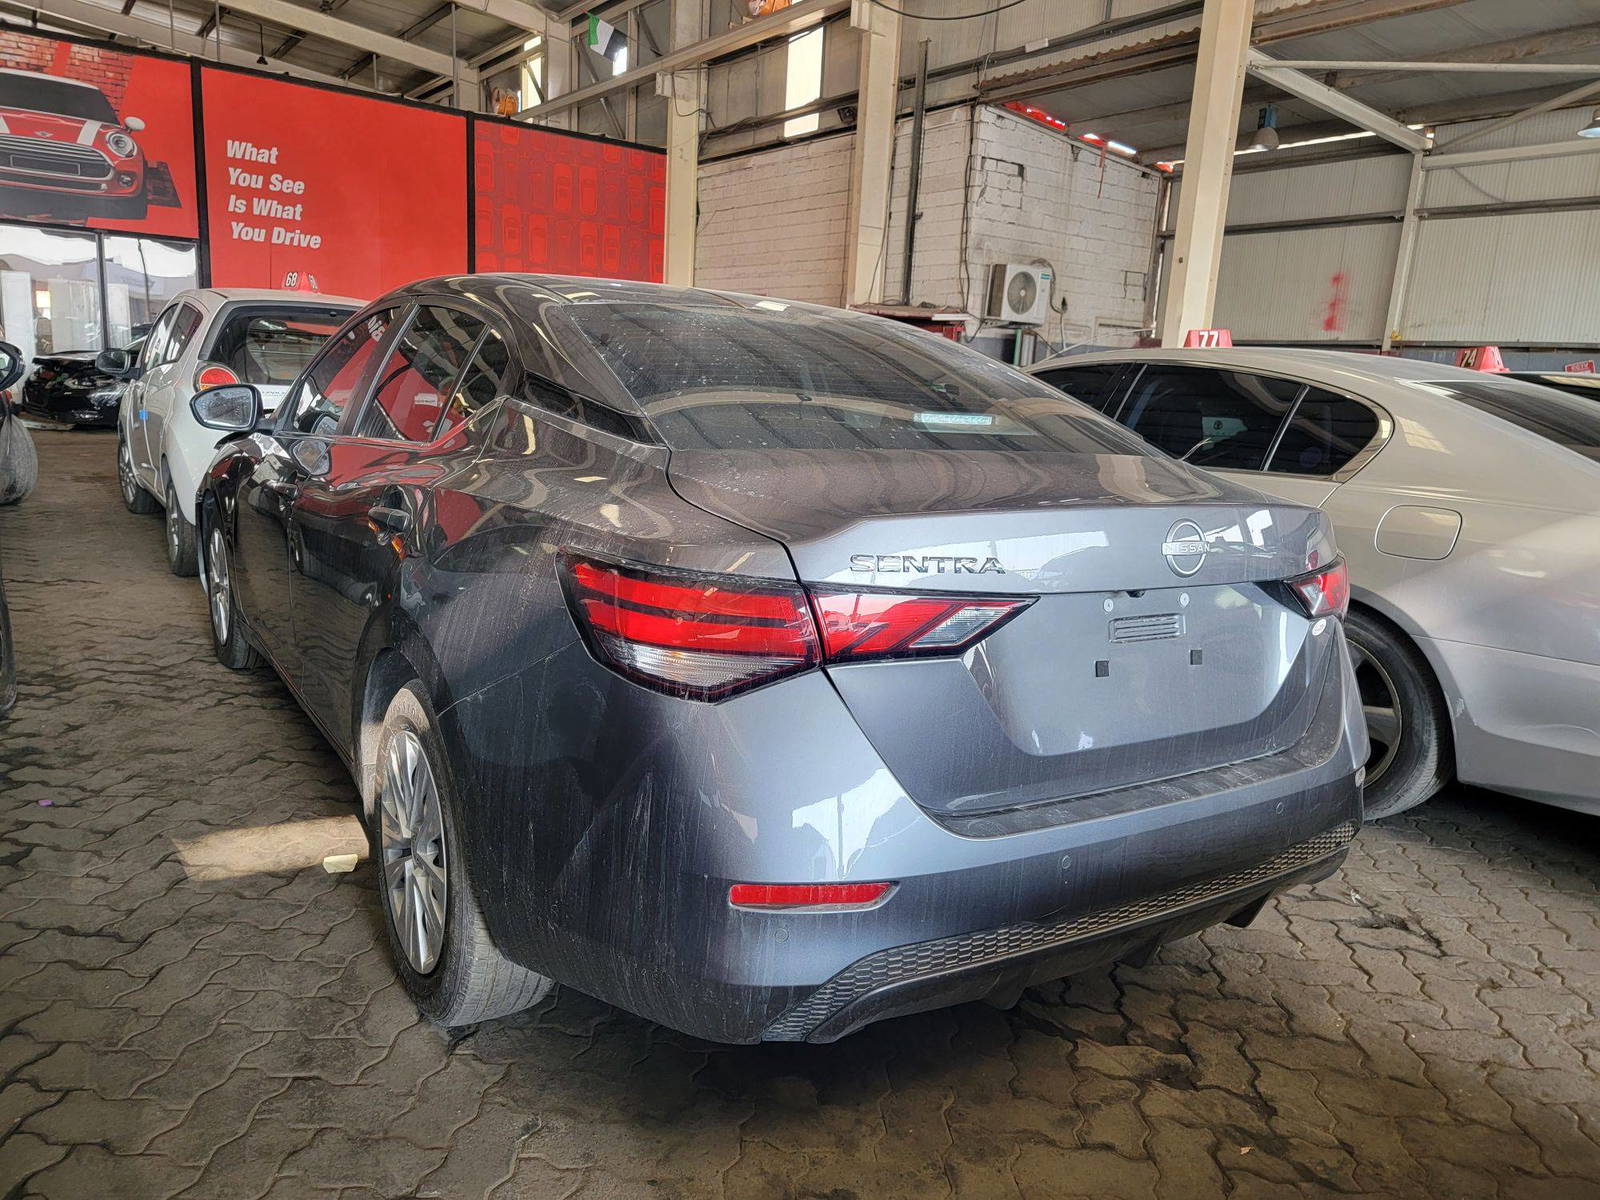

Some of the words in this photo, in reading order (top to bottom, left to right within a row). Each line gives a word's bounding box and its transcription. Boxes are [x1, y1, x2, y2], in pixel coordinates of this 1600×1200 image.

[226, 139, 279, 165] What
[228, 167, 264, 189] You
[268, 173, 305, 195] See
[227, 194, 247, 213] Is
[252, 197, 303, 221] What
[231, 221, 267, 242] You
[271, 226, 322, 249] Drive
[285, 271, 298, 288] 68
[1199, 330, 1219, 348] 77
[1460, 348, 1478, 368] 74
[849, 554, 1006, 575] SENTRA
